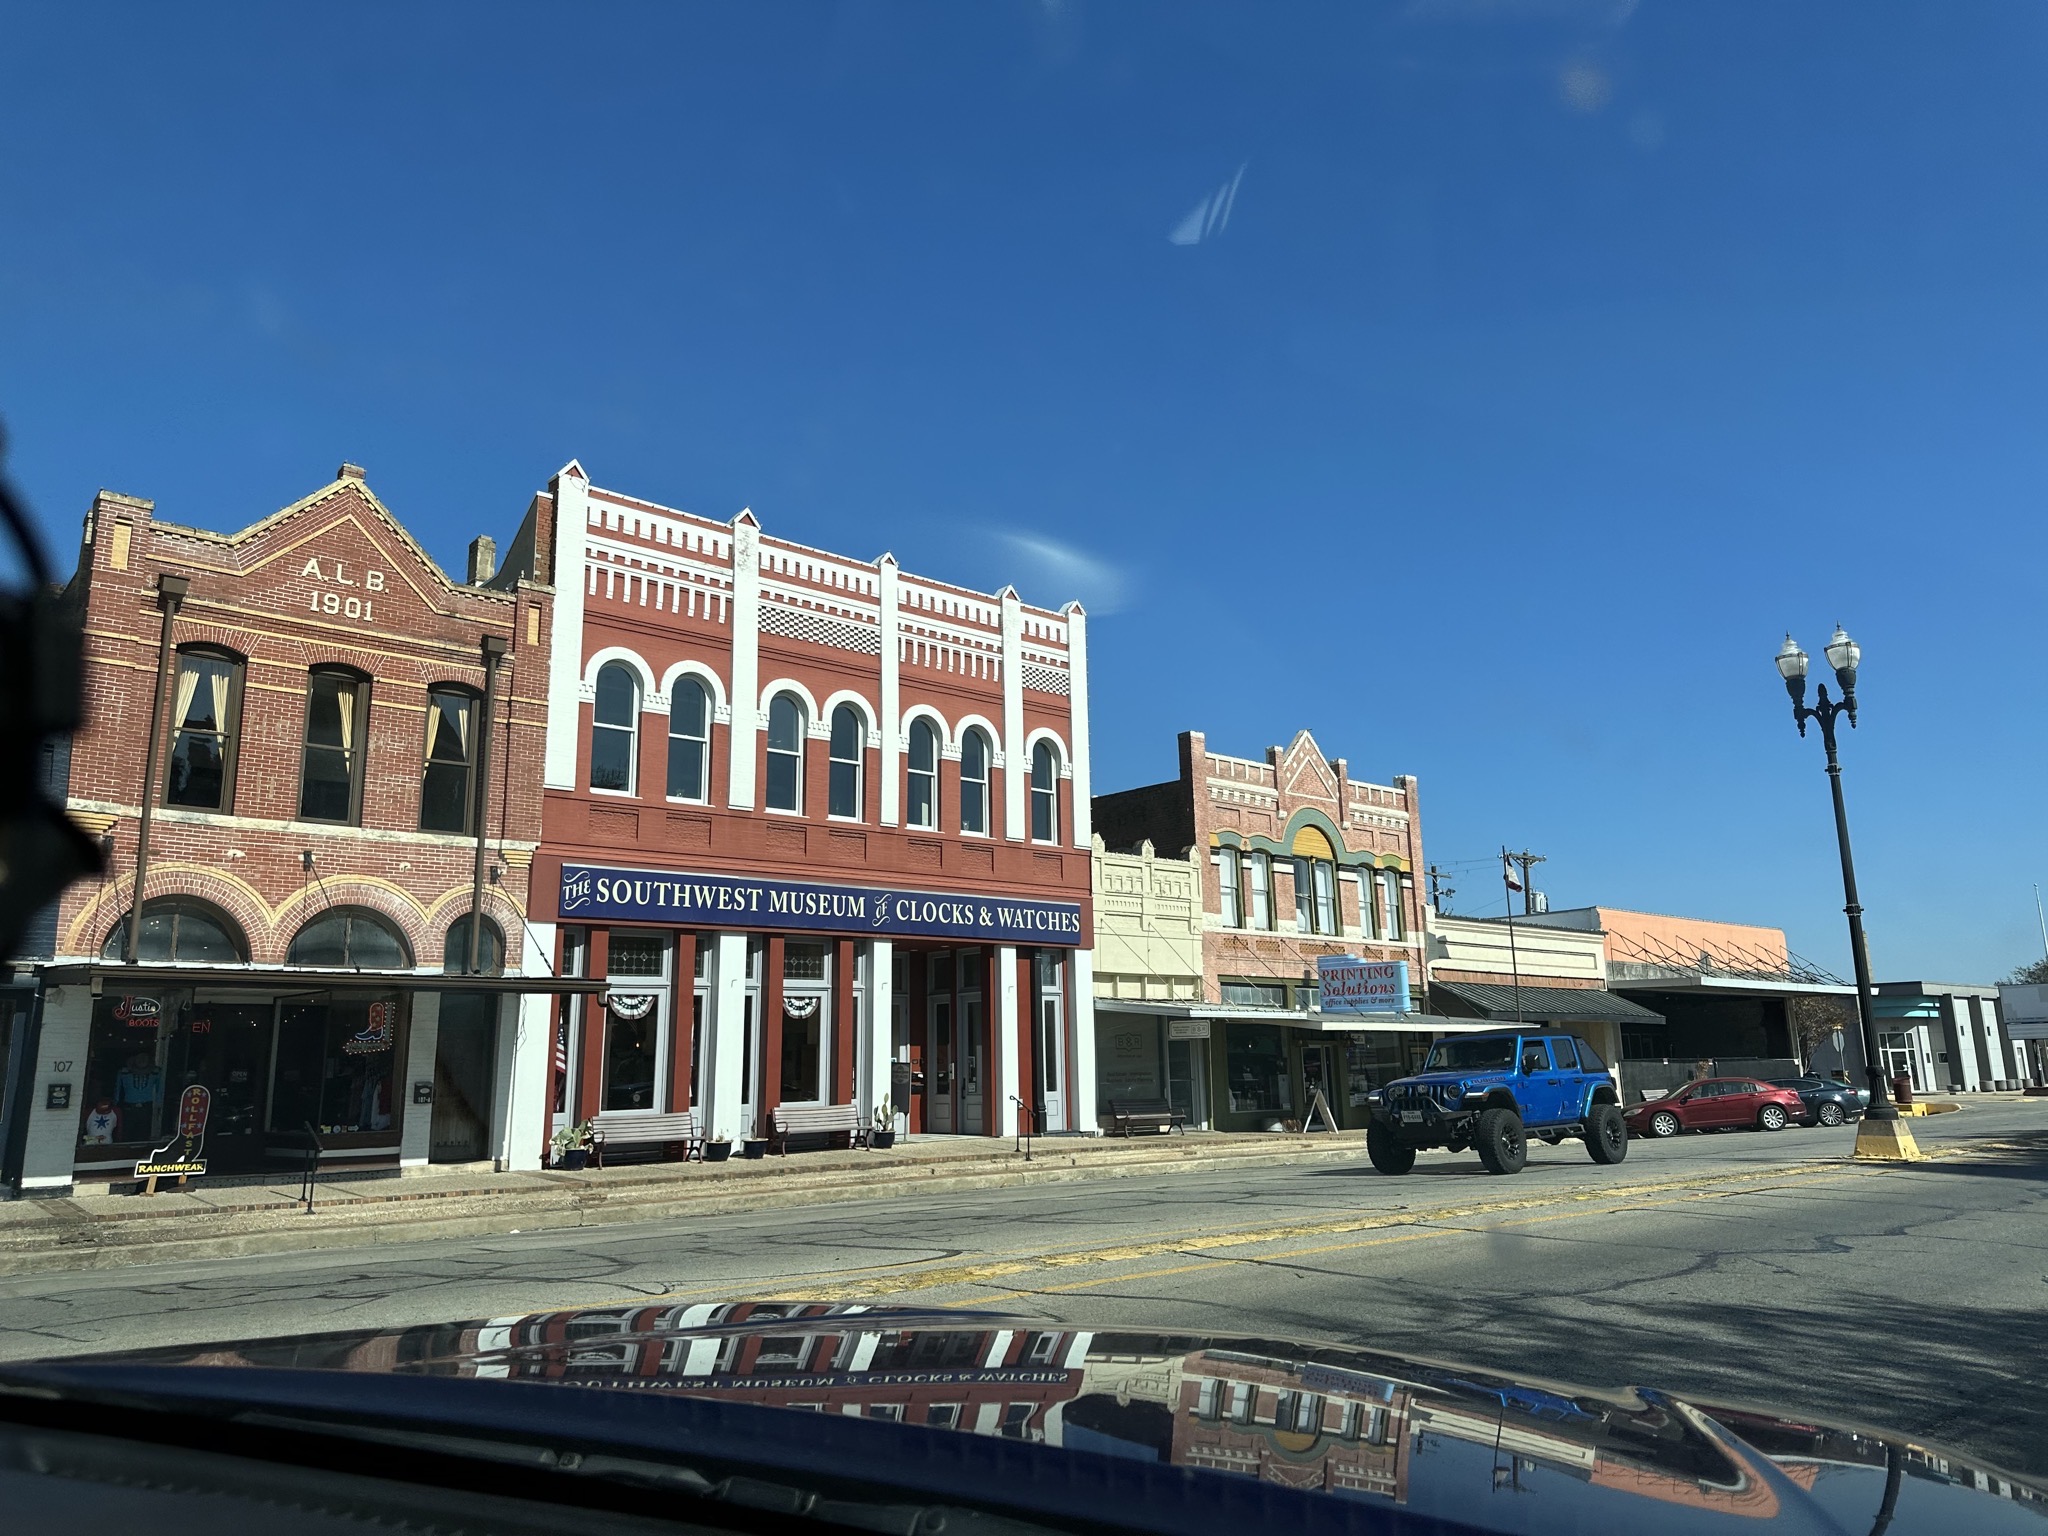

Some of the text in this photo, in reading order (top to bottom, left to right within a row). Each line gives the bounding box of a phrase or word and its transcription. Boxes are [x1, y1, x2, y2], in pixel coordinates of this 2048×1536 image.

[310, 590, 373, 622] 1901
[562, 879, 592, 901] THE
[596, 878, 763, 912] SOUTHWEST
[768, 890, 866, 918] MUSEUM
[896, 899, 974, 925] CLOCKS
[979, 906, 994, 927] &
[997, 907, 1080, 932] WATCHES
[1321, 965, 1395, 982] PRINTING
[1323, 980, 1396, 997] Solutions
[1325, 998, 1342, 1008] office
[1343, 997, 1369, 1008] supplies
[128, 1018, 160, 1028] BOOTS
[53, 1060, 73, 1073] 107
[183, 1088, 202, 1156] ROLLFAST
[137, 1163, 204, 1174] RANCHWEAR
